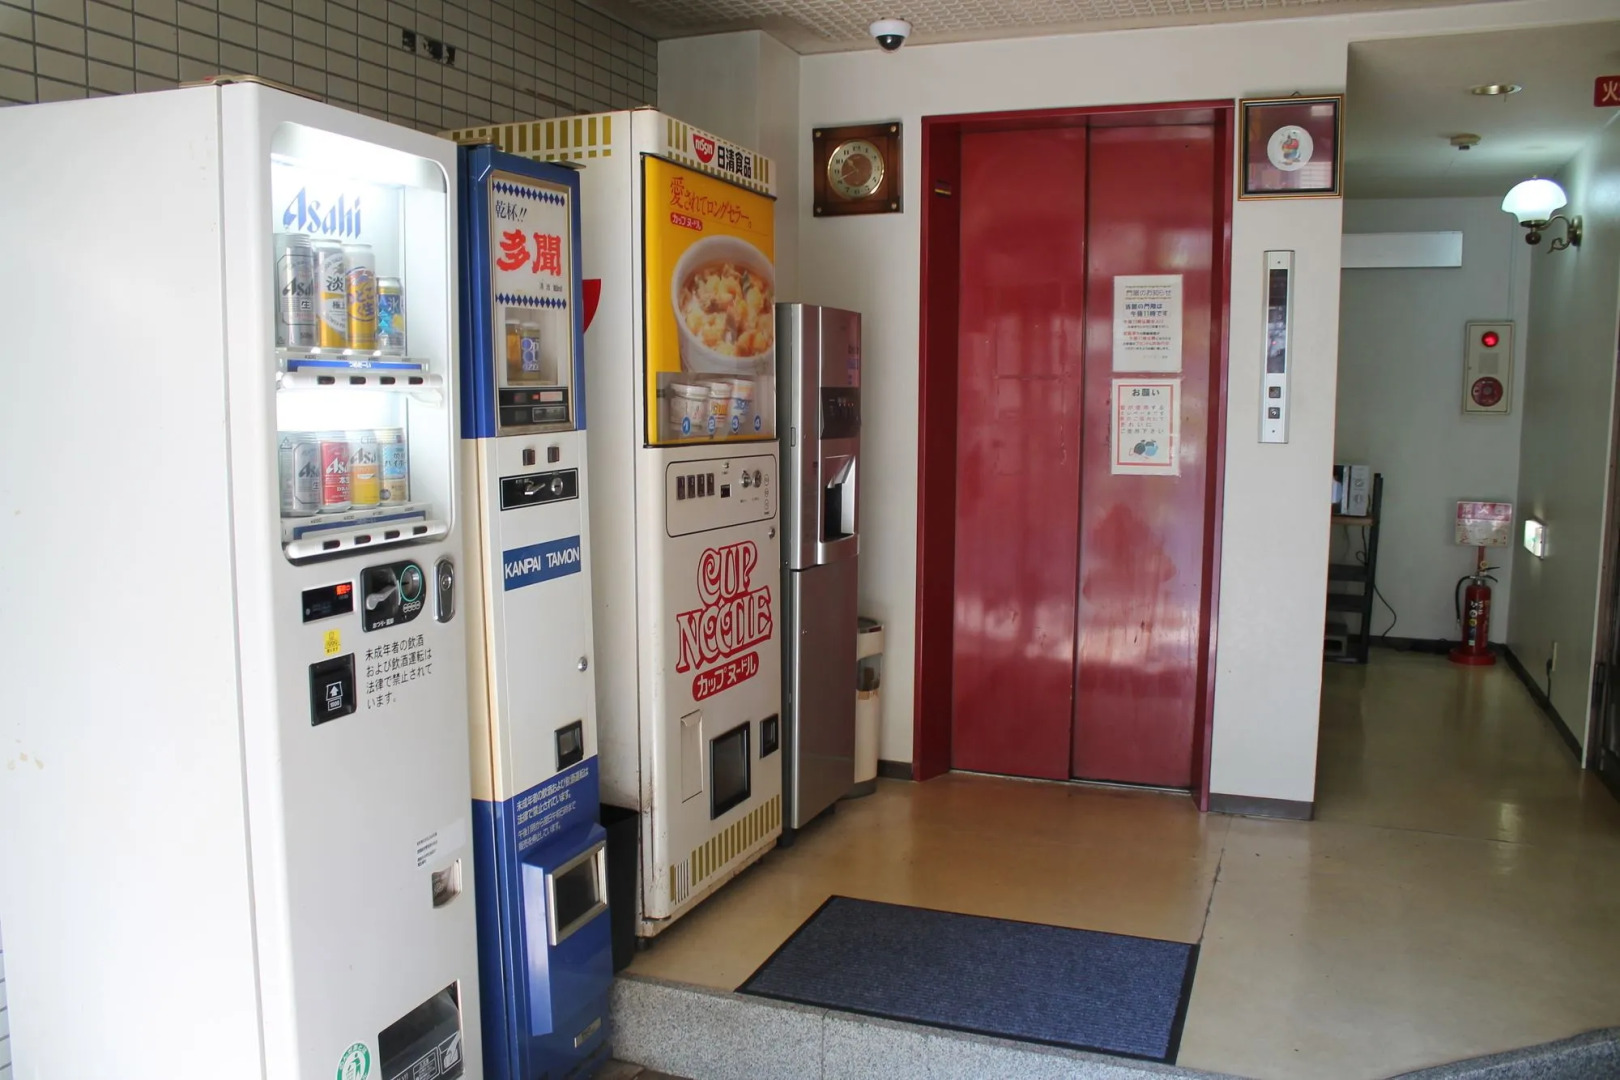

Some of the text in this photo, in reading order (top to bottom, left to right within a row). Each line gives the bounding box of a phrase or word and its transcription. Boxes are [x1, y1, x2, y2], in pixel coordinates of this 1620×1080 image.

[1602, 80, 1620, 102] 火
[717, 144, 752, 179] 日清食品
[282, 186, 361, 239] Asahi
[496, 229, 562, 276] 多聞
[504, 547, 580, 579] KANPAI TAMON
[697, 540, 758, 605] CUP
[676, 585, 773, 674] NOODLE
[365, 633, 424, 661] 未成年者の飲酒
[366, 648, 432, 678] および飲酒運転は
[366, 663, 433, 694] 法律で禁止されて
[697, 656, 756, 698] カップヌードル
[367, 692, 397, 709] います。
